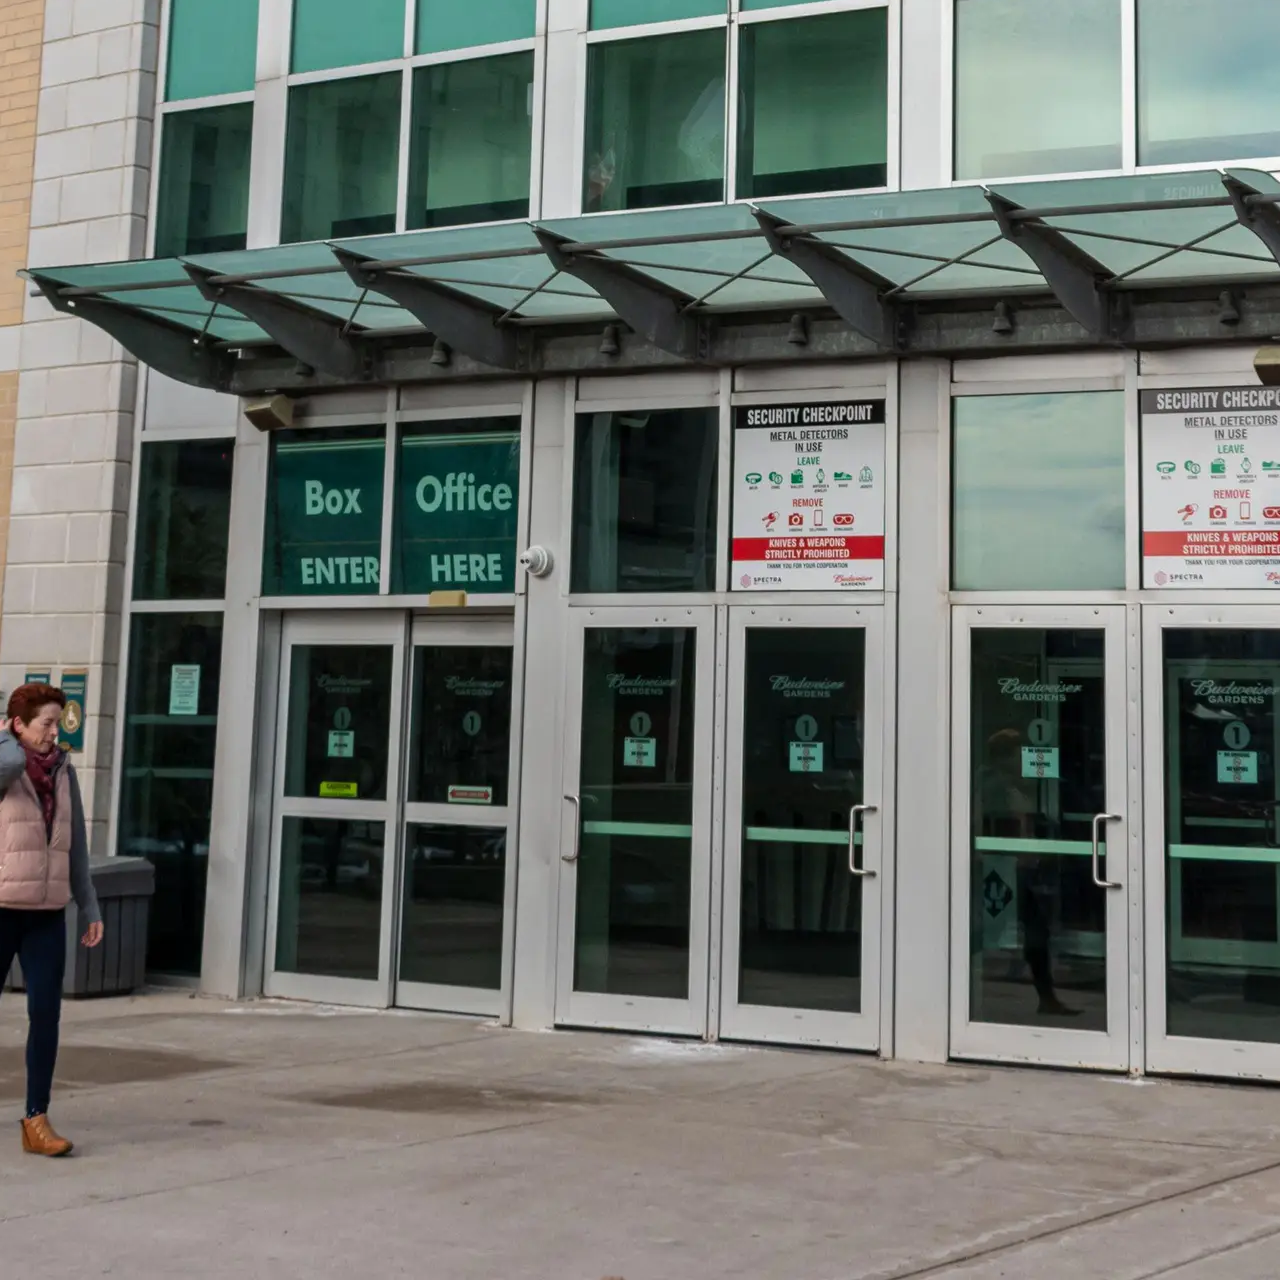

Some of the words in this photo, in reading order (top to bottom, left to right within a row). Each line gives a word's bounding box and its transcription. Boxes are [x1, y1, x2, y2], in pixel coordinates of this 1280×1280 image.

[1157, 392, 1219, 410] SECURITY
[747, 408, 800, 426] SECURITY
[802, 404, 873, 423] CHECKPOINT
[1185, 416, 1216, 428] METAL
[1220, 415, 1278, 427] DETECTORS
[770, 430, 797, 442] METAL
[800, 428, 849, 440] DETECTORS
[1215, 429, 1225, 440] IN
[1227, 428, 1248, 440] USE
[795, 443, 804, 452] IN
[806, 442, 823, 452] USE
[1217, 444, 1245, 454] LEAVE
[797, 456, 821, 466] LEAVE
[305, 480, 362, 516] Box
[416, 472, 513, 513] Office
[1213, 489, 1251, 499] REMOVE
[792, 498, 824, 508] REMOVE
[769, 538, 797, 548] KNIVES
[799, 538, 805, 547] &
[807, 537, 846, 548] WEAPONS
[1187, 532, 1220, 543] KNIVES
[1222, 532, 1230, 542] &
[1233, 532, 1279, 542] WEAPONS
[765, 549, 801, 559] STRICTLY
[803, 549, 850, 559] PROHIBITED
[1183, 544, 1226, 555] STRICTLY
[301, 556, 380, 585] ENTER
[431, 553, 503, 583] HERE
[1170, 573, 1204, 581] SPECTRA
[998, 677, 1083, 694] Budweiser
[619, 687, 663, 696] GARDENS
[783, 689, 831, 698] GARDENS
[1013, 693, 1066, 702] GARDENS
[1208, 695, 1265, 704] GARDENS
[637, 716, 644, 734] 1
[803, 719, 810, 737] 1
[1036, 724, 1043, 741] 1
[1232, 726, 1240, 745] 1
